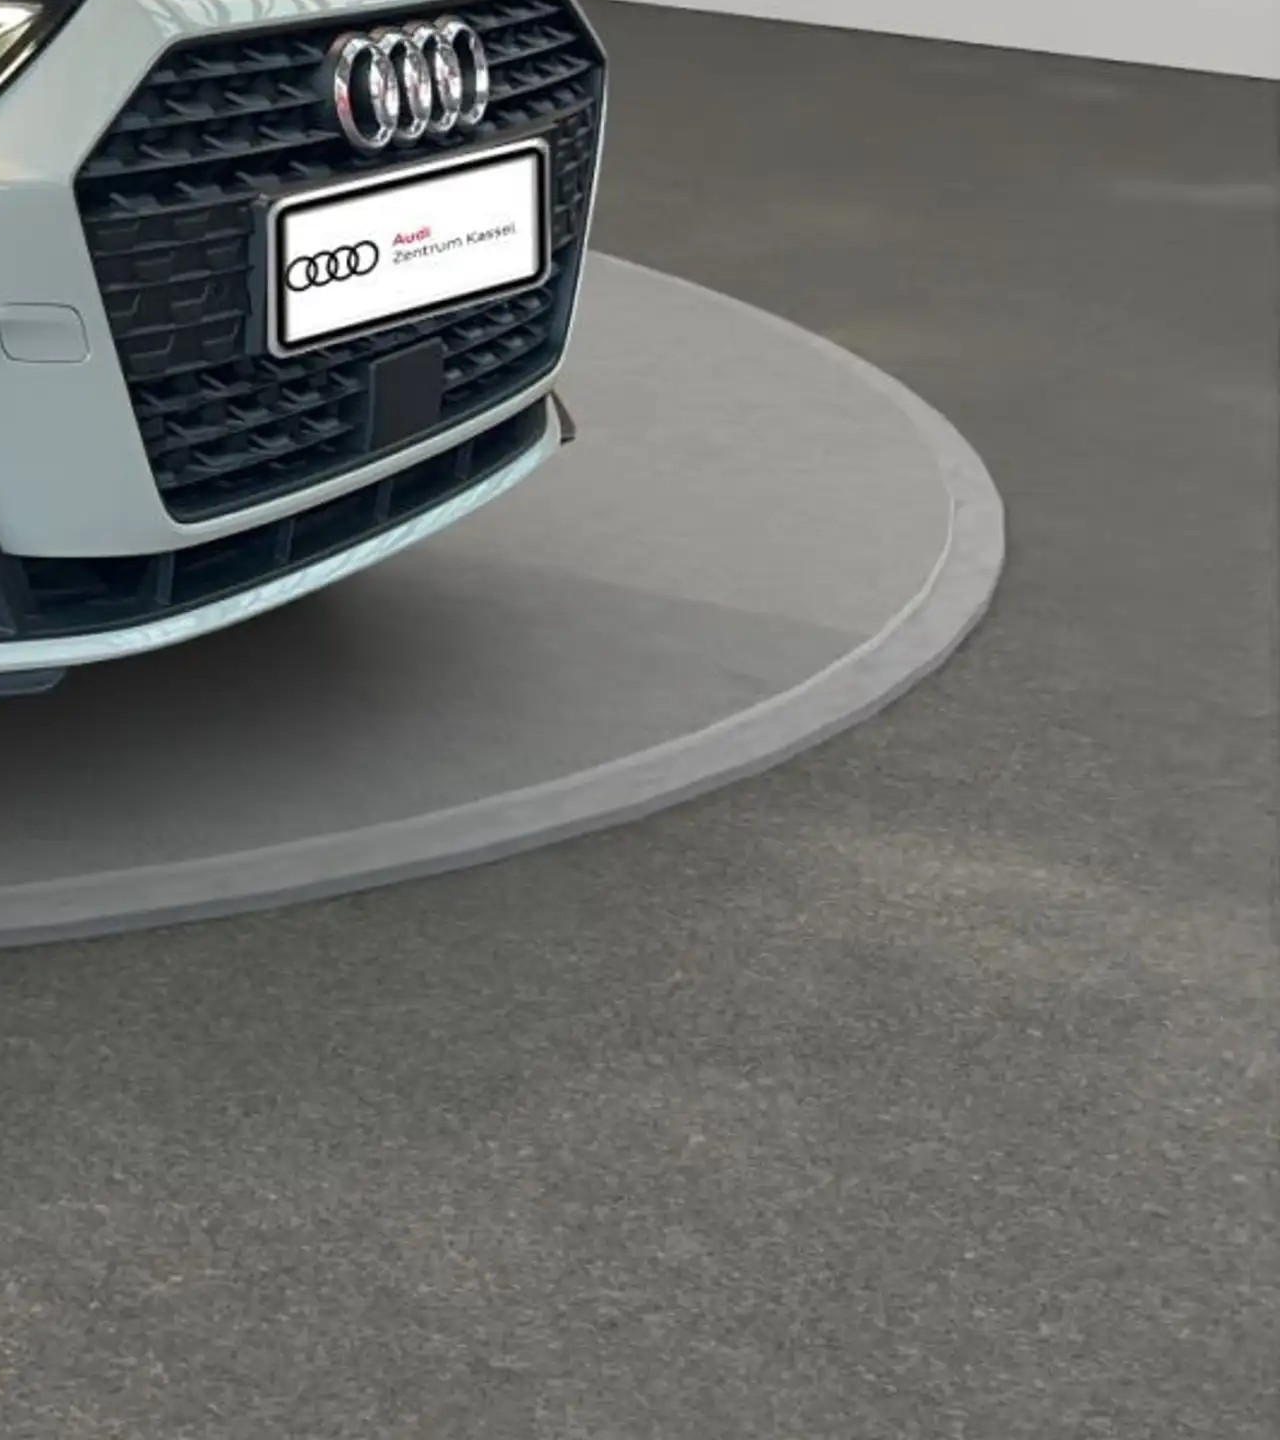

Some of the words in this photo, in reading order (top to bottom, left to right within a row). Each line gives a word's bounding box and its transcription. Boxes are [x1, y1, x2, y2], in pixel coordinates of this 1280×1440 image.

[393, 225, 431, 247] Audi
[393, 237, 463, 265] Zentrum
[466, 221, 516, 245] Kassel
